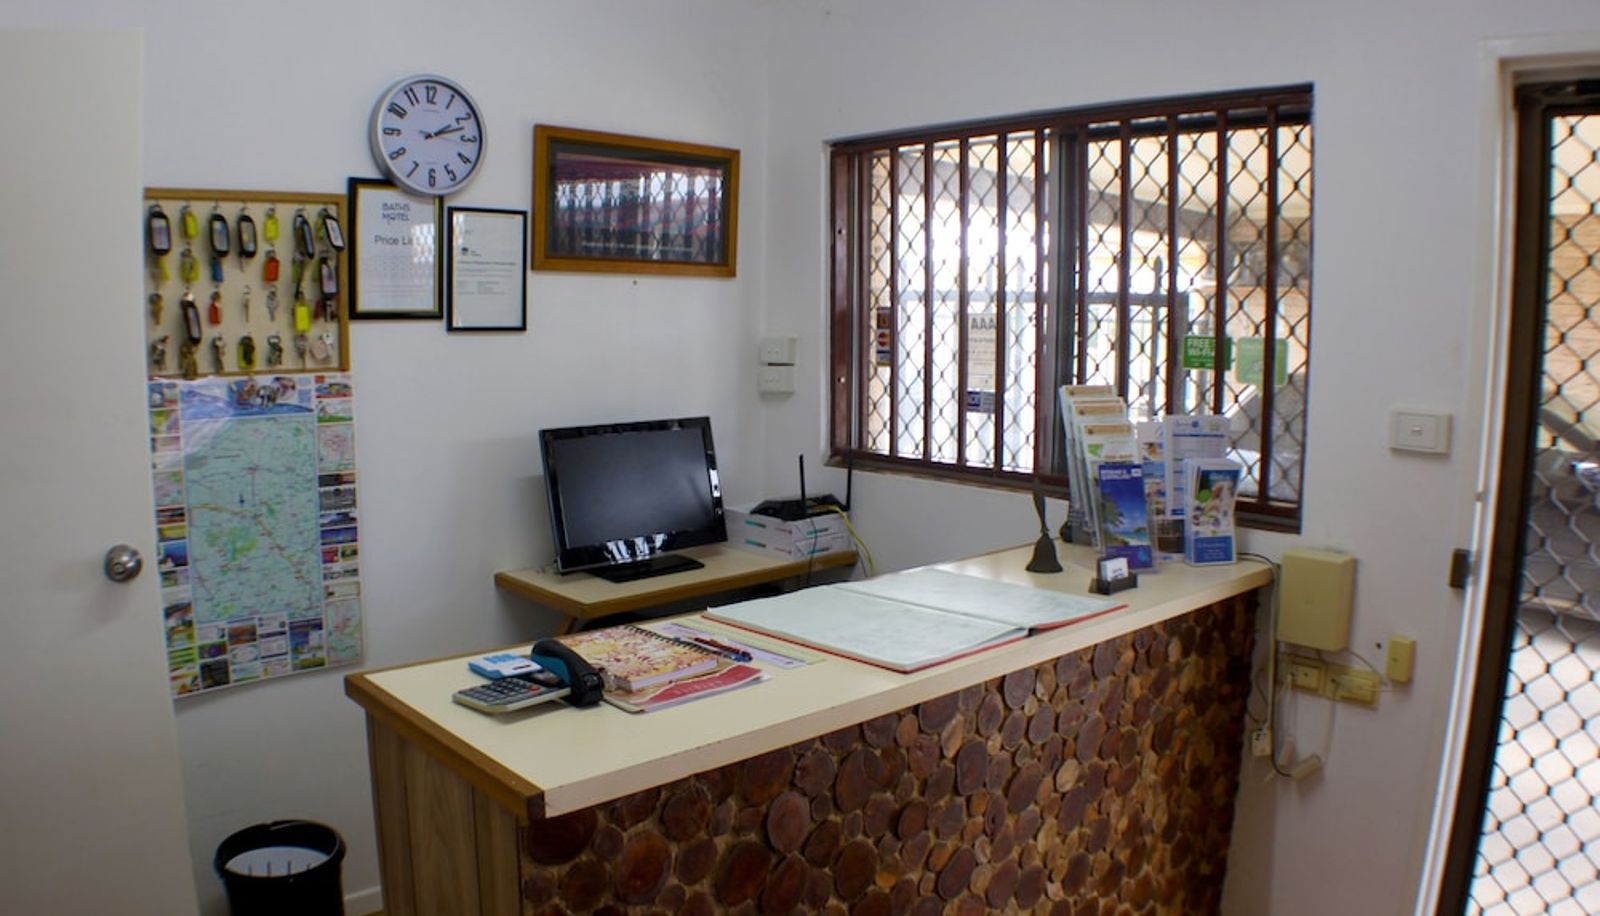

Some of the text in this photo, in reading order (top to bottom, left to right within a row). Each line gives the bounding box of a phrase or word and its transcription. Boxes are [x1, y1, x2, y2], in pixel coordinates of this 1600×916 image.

[404, 87, 420, 106] 11
[425, 85, 437, 105] 12
[445, 94, 456, 110] 1
[387, 102, 408, 119] 10
[455, 112, 472, 125] 2
[383, 127, 401, 136] 9
[460, 134, 477, 143] 3
[389, 147, 406, 160] 8
[457, 152, 472, 165] 4
[406, 160, 419, 178] 7
[443, 163, 457, 182] 5
[428, 168, 436, 187] 6
[382, 212, 410, 221] MOTEL
[374, 235, 399, 245] Price
[970, 317, 997, 329] AAA
